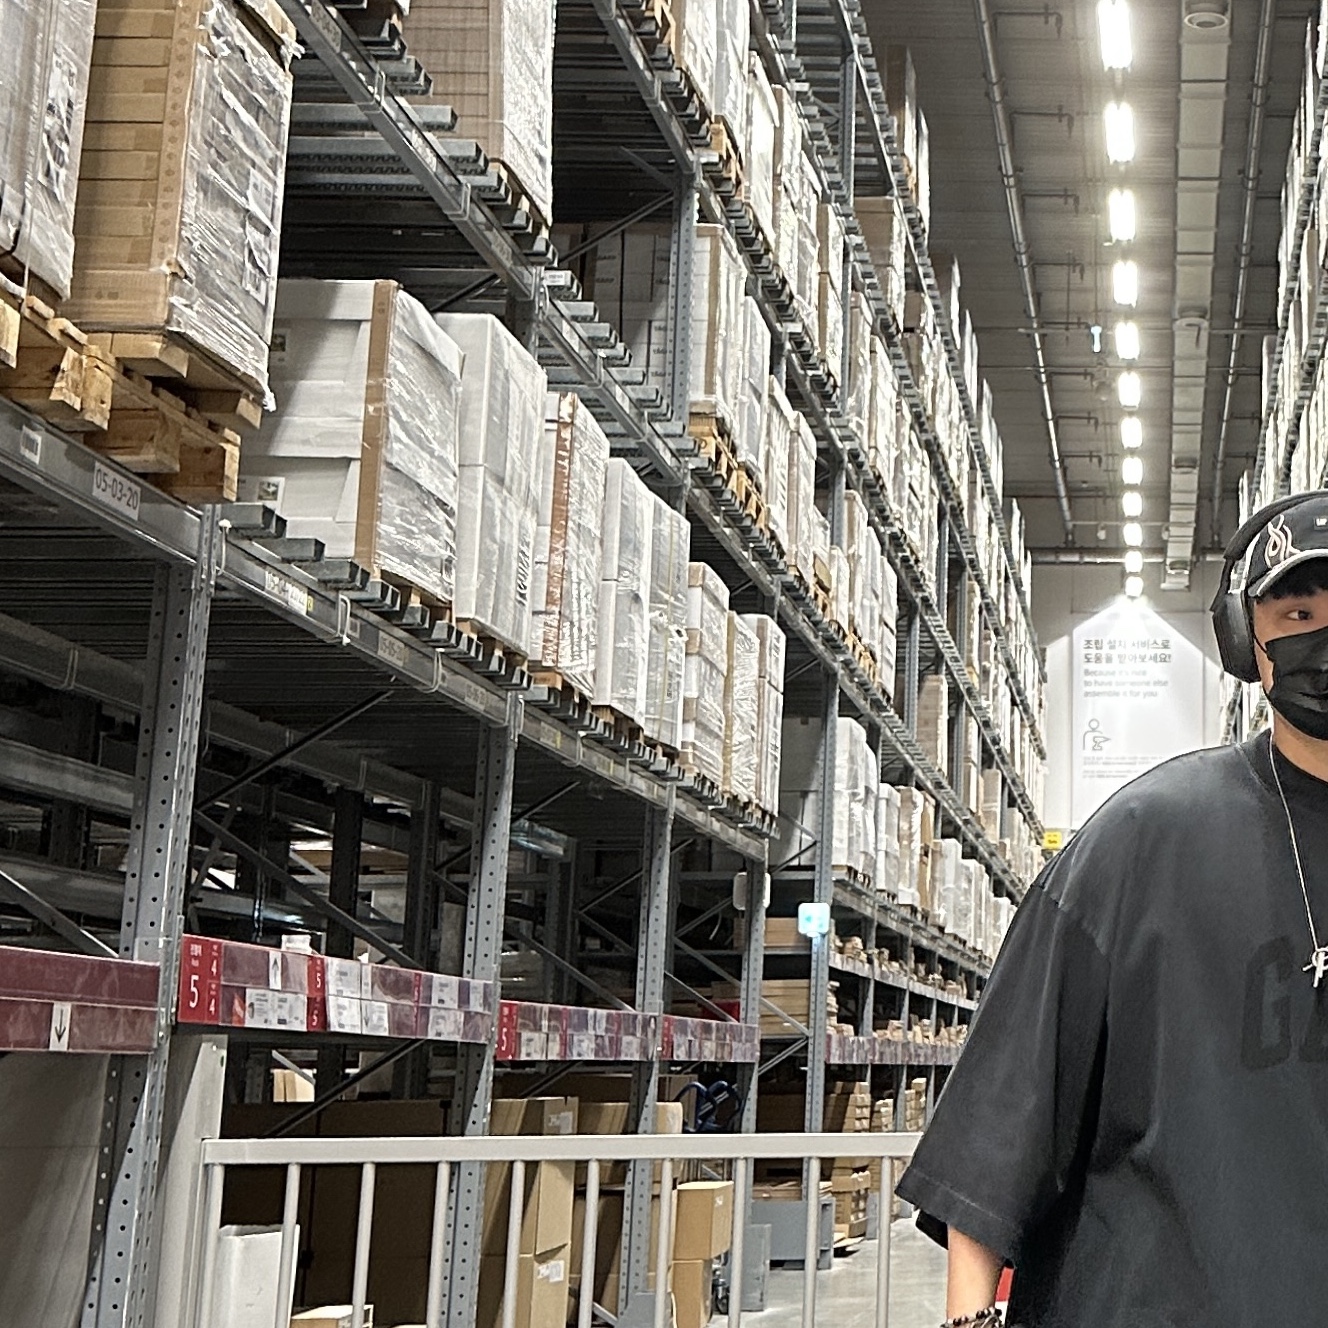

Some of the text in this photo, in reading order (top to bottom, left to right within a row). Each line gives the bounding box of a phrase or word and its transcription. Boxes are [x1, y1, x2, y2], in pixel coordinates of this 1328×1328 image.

[95, 468, 139, 511] 05-03-20
[1083, 639, 1103, 650] 조립
[1131, 639, 1171, 650] 서비스로
[1083, 653, 1113, 664] 도움을
[1083, 668, 1116, 677] Because
[1083, 679, 1092, 687] to
[1094, 679, 1112, 687] have
[1152, 679, 1169, 687] else
[1083, 690, 1120, 698] assemble
[1129, 690, 1140, 698] for
[1142, 691, 1158, 699] you
[210, 959, 217, 976] 4
[315, 973, 322, 989] 5
[189, 975, 200, 1009] 5
[208, 999, 216, 1016] 4
